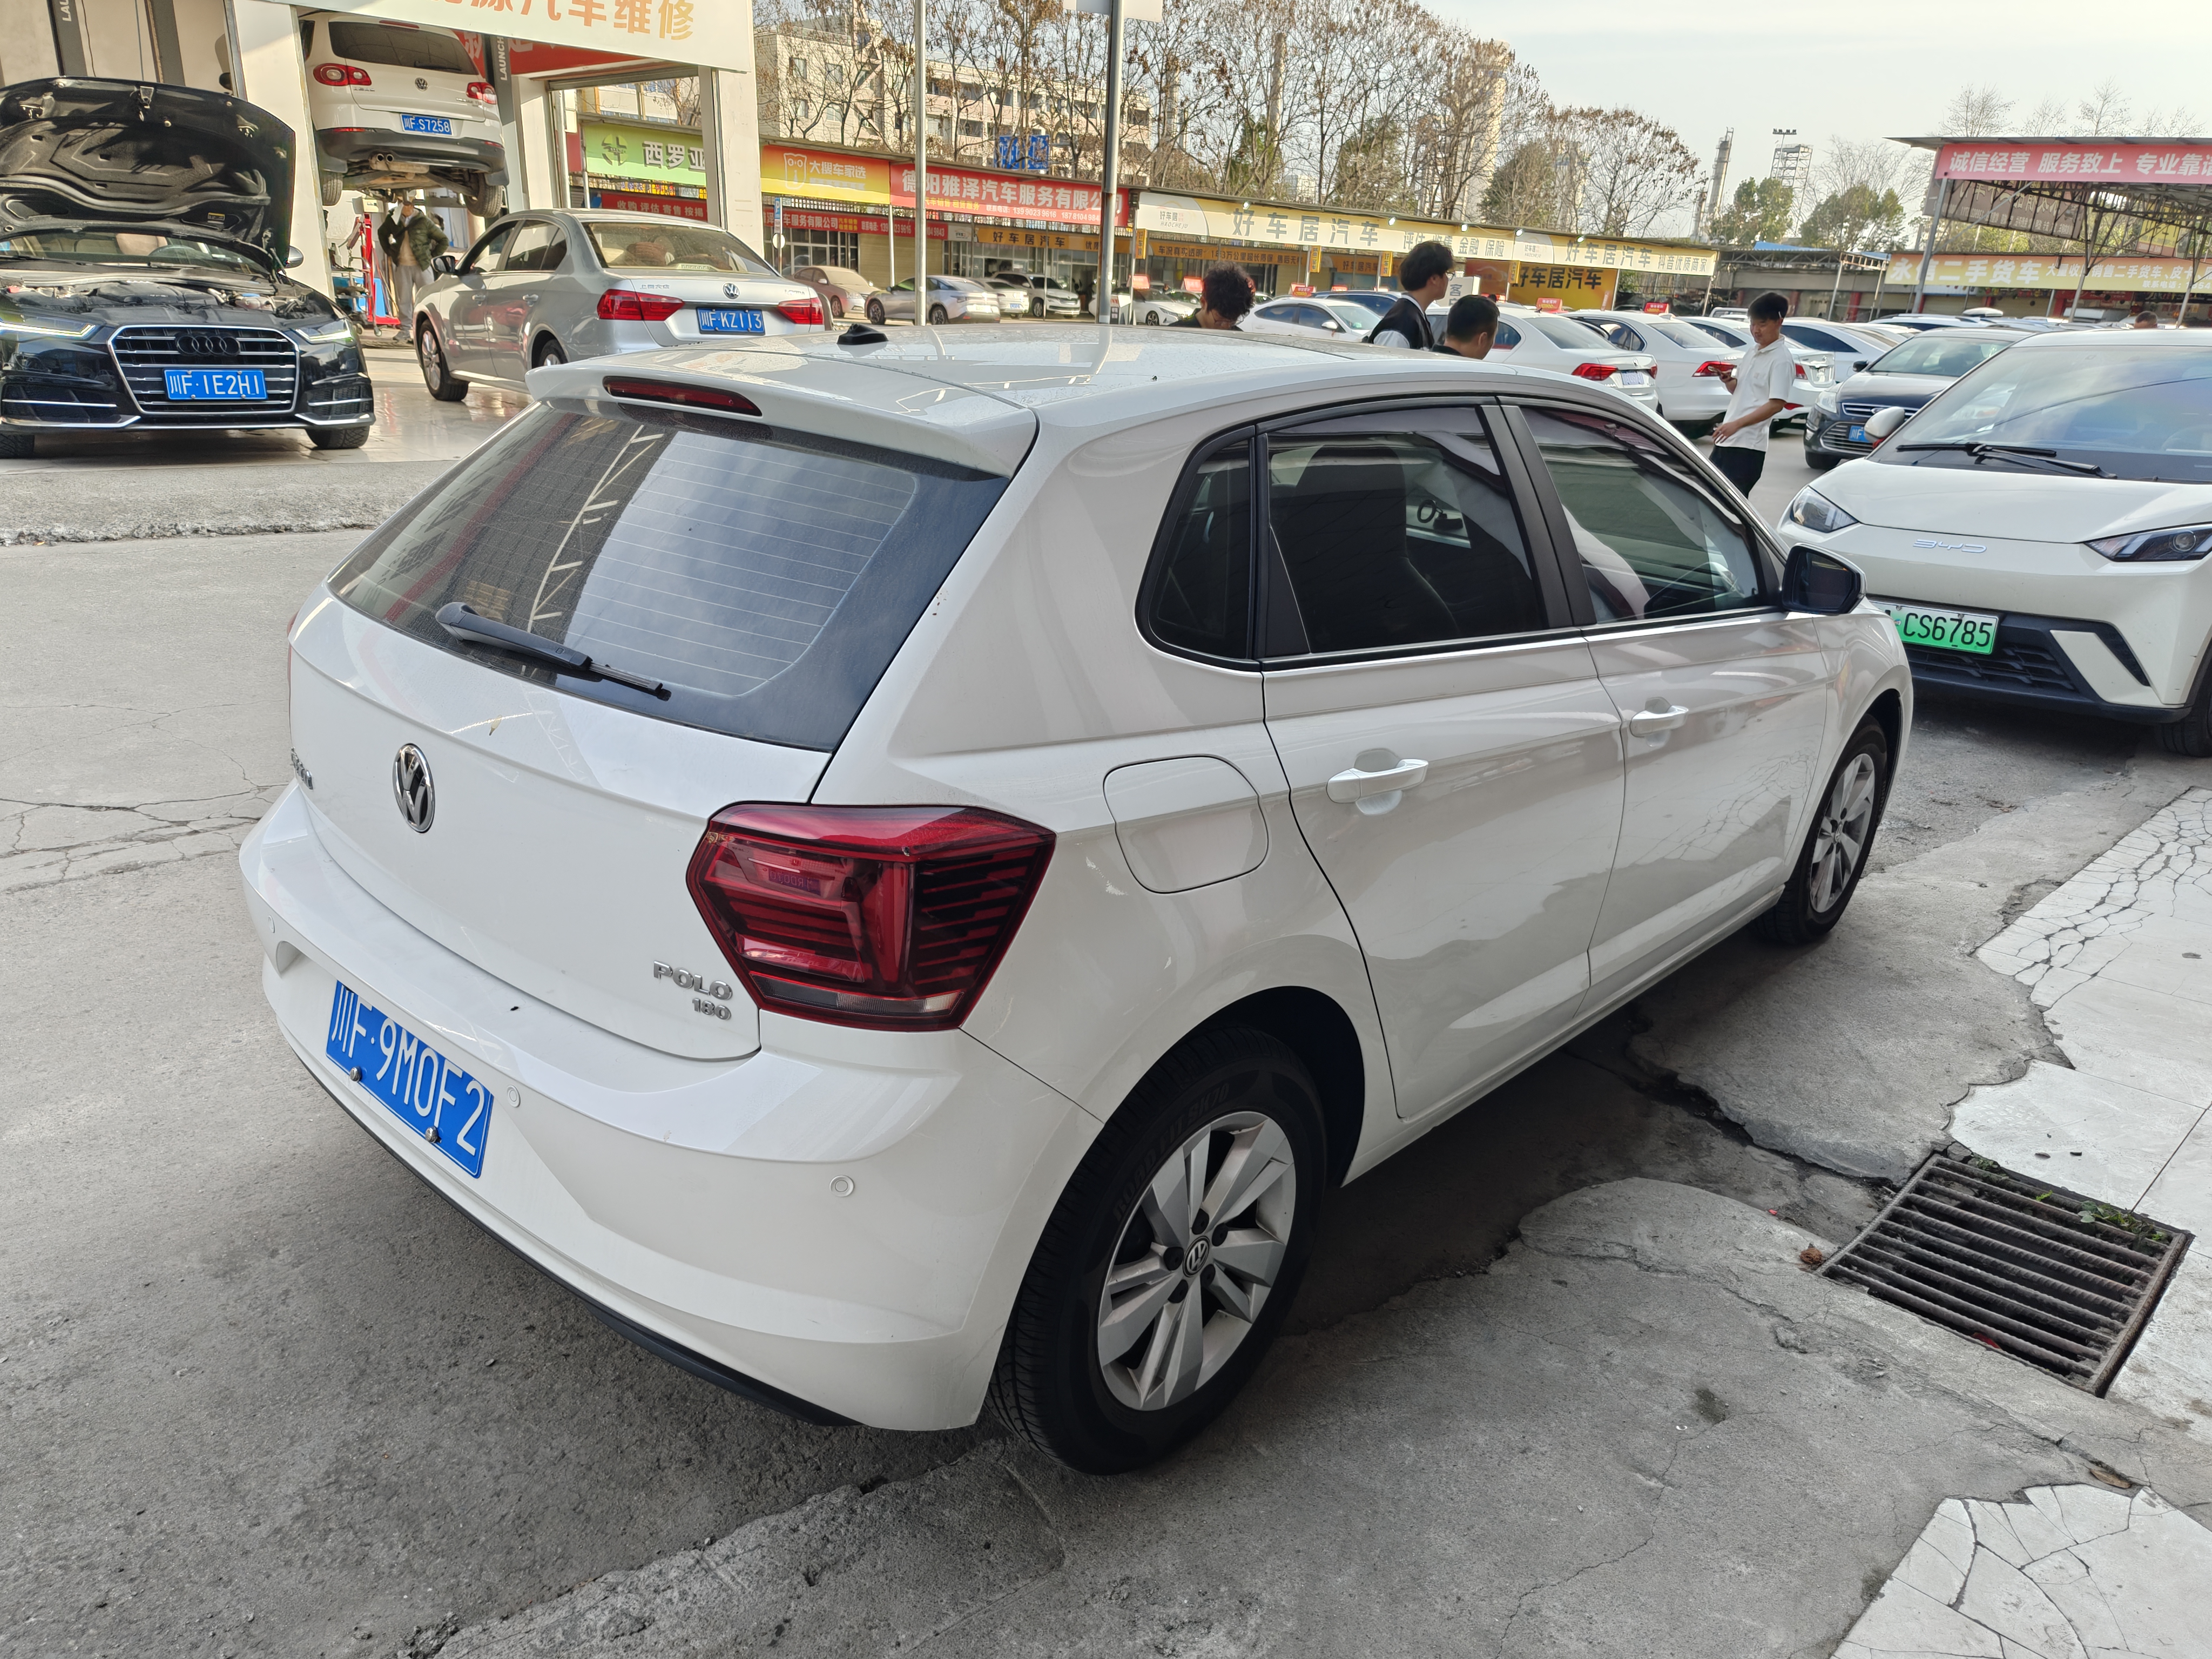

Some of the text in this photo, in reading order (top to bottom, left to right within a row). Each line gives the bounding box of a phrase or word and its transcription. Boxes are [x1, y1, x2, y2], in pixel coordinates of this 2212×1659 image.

[1948, 152, 2031, 173] 诚信经营
[2038, 152, 2123, 174] 服务致上
[993, 231, 1065, 247] 好车居汽车
[1232, 208, 1379, 246] 好车居汽车
[1458, 238, 1480, 255] 金融
[1485, 239, 1505, 258] 保险
[1565, 240, 1707, 273] 好车居汽车 抖音优质商家
[1890, 258, 2042, 285] 永信二手货车
[1912, 539, 1987, 554] BYD
[1885, 610, 1993, 647] CS6785
[653, 960, 733, 1001] POLO
[692, 997, 732, 1020] 180
